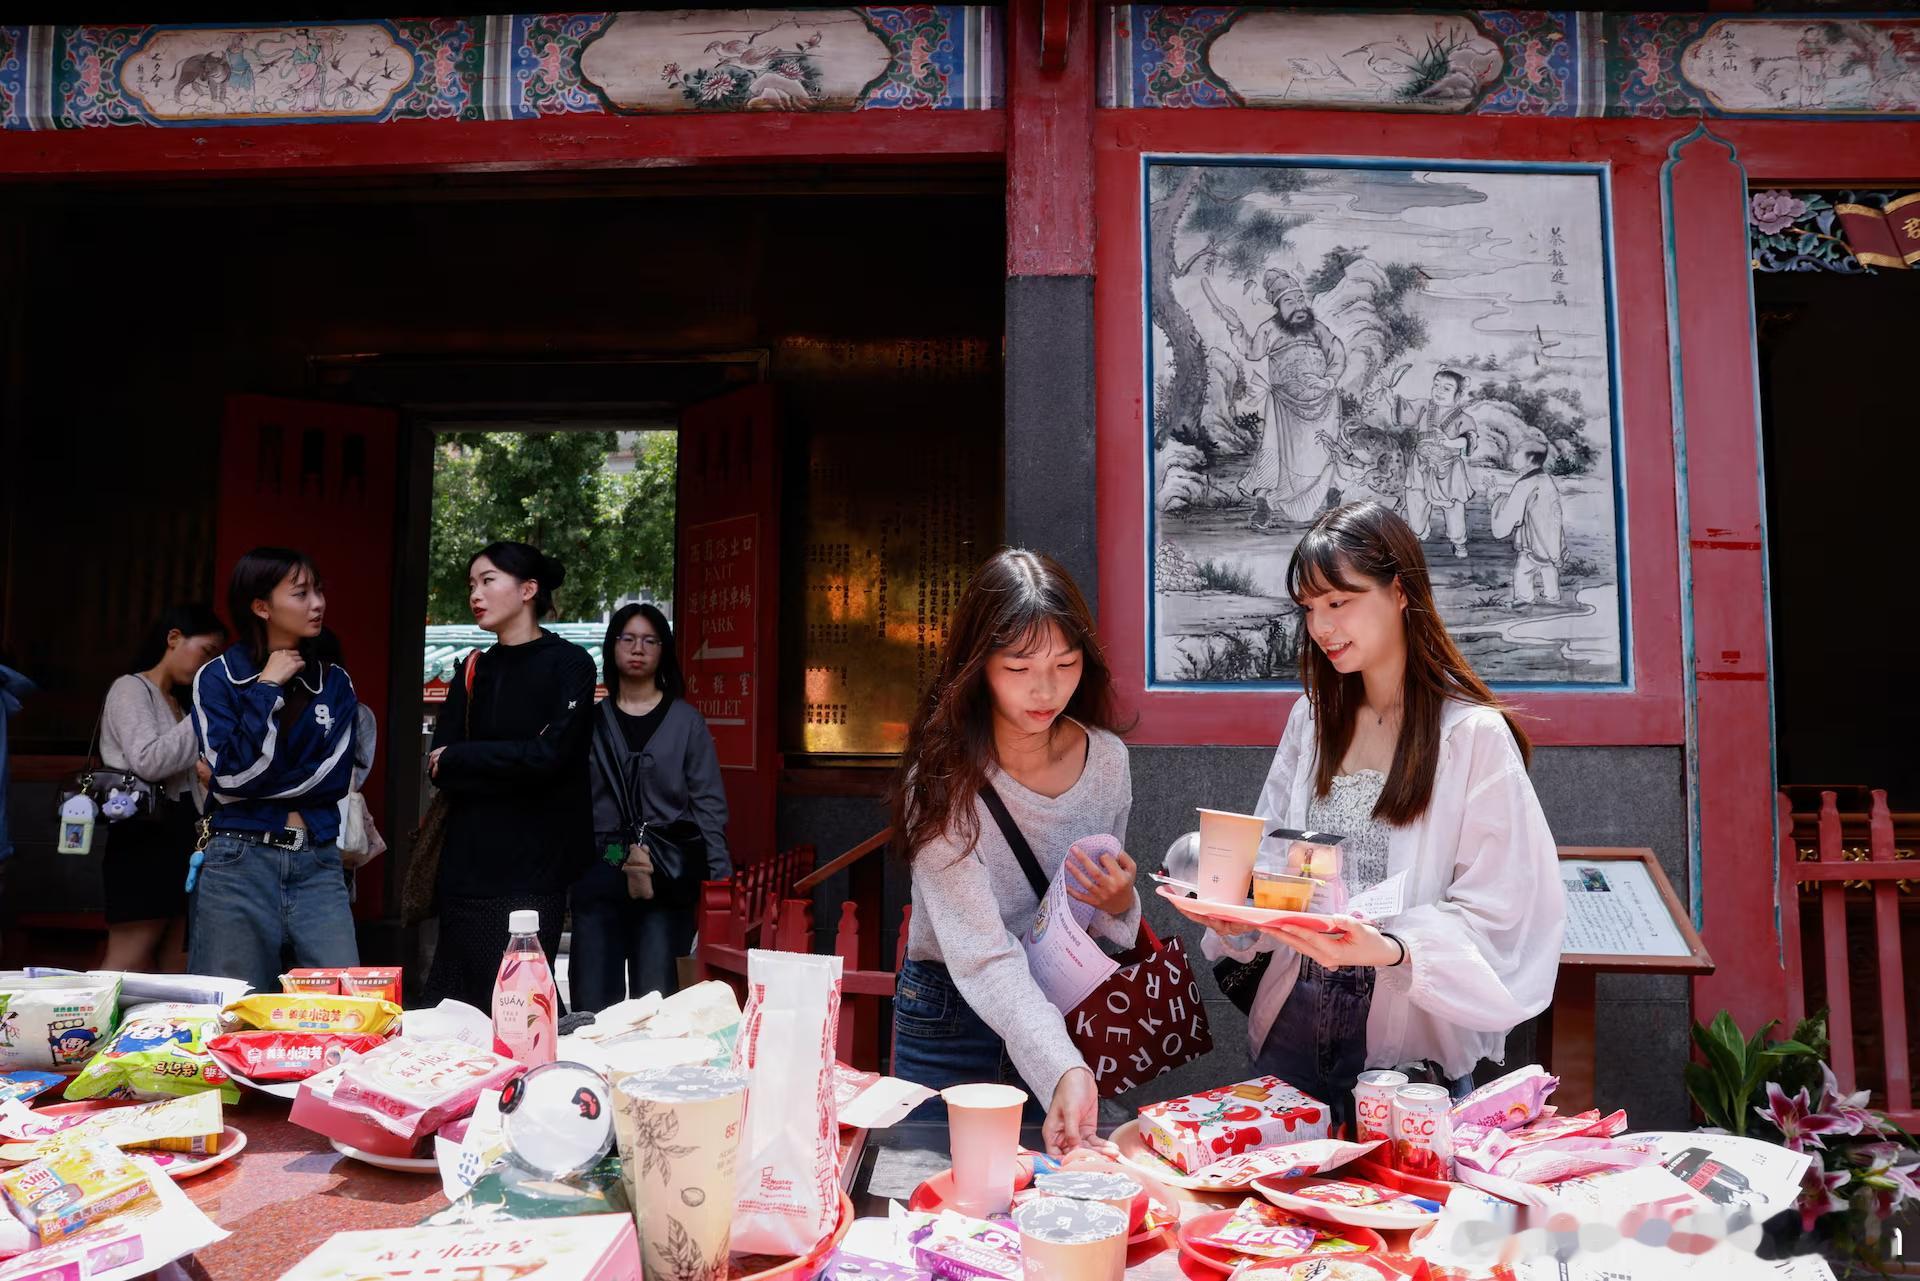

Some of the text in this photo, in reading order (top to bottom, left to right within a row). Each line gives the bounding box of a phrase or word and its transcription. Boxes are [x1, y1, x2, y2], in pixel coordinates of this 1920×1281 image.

[704, 564, 733, 583] EXIT
[702, 617, 735, 634] PARK
[695, 699, 741, 717] TOILET
[289, 1009, 342, 1023] 義美小泡芙
[266, 1046, 324, 1061] 義美小泡芙
[1358, 1101, 1388, 1119] C&C
[1401, 1117, 1436, 1136] C&C
